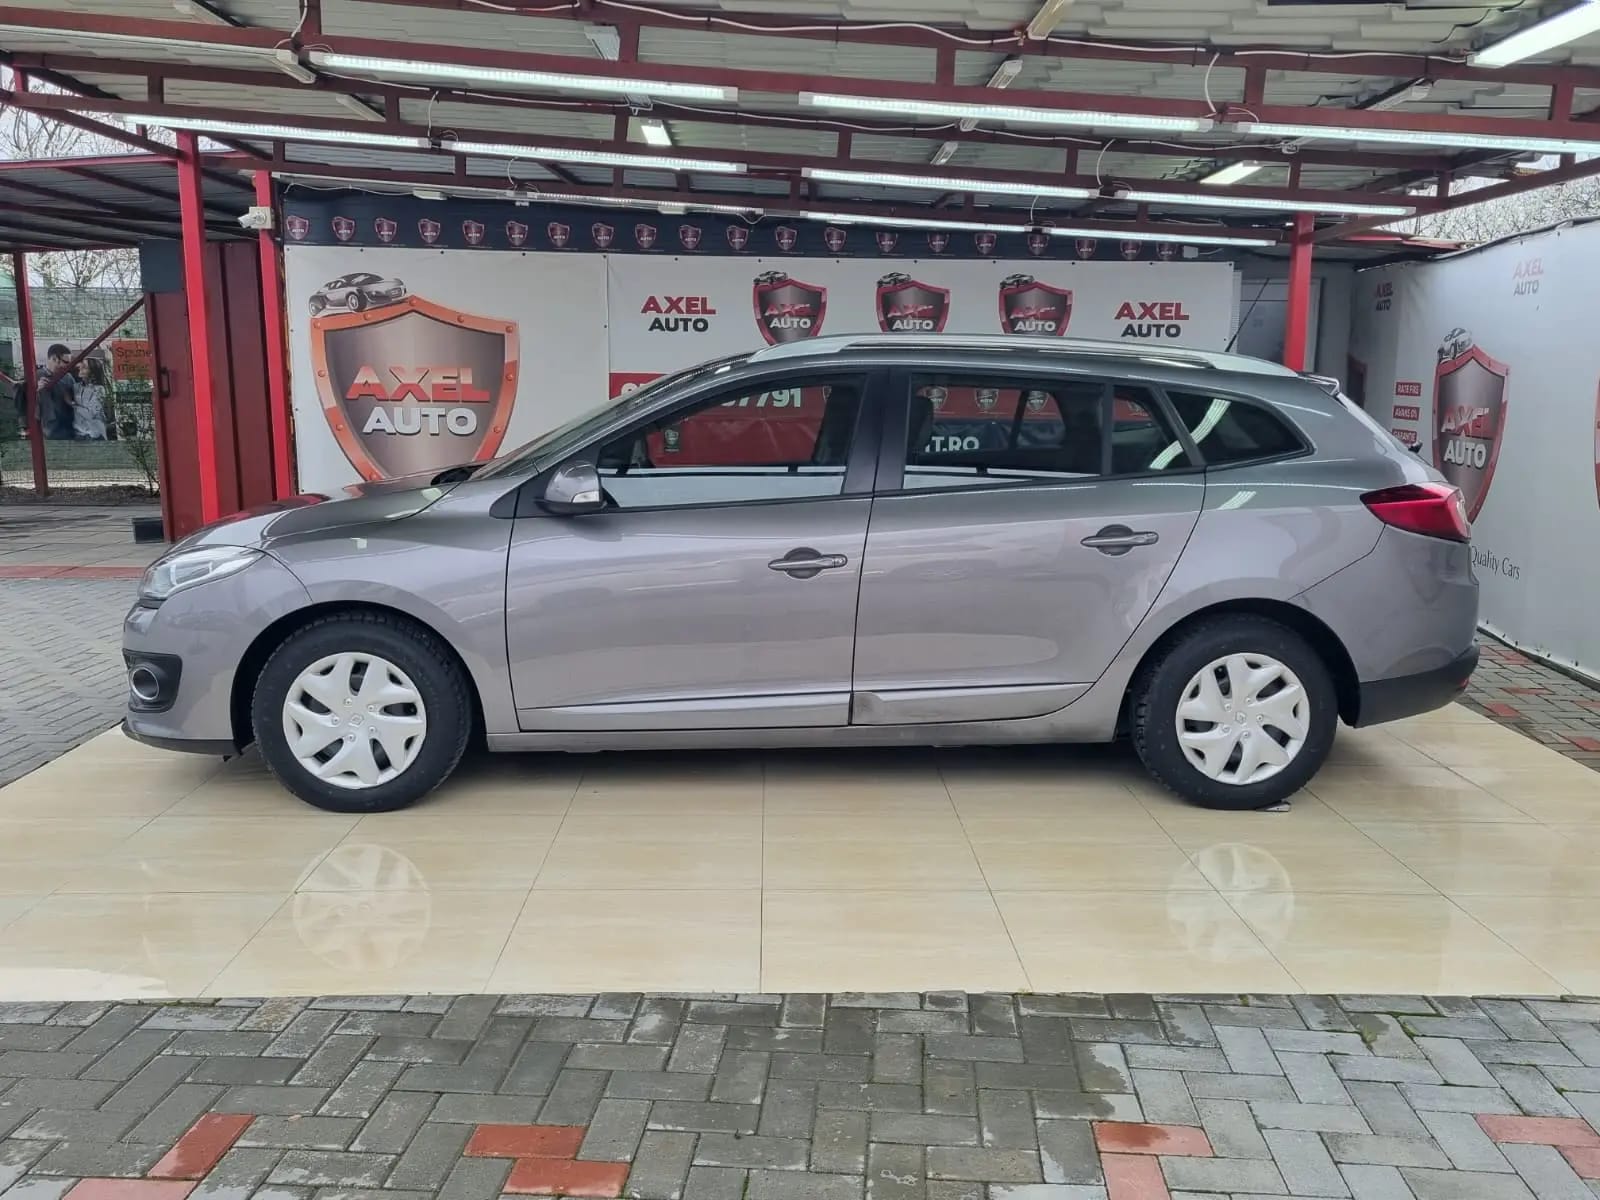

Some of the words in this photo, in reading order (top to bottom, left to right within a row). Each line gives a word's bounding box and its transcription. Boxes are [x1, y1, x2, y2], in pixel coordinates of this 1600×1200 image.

[1512, 257, 1544, 280] AXEL
[1513, 279, 1539, 296] AUTO
[641, 295, 717, 315] AXEL
[1114, 302, 1190, 320] AXEL
[648, 317, 709, 332] AUTO
[769, 318, 811, 329] AUTO
[892, 319, 934, 330] AUTO
[1014, 320, 1057, 331] AUTO
[1121, 323, 1182, 338] AUTO
[345, 365, 491, 403] AXEL
[362, 406, 478, 436] AUTO
[1441, 404, 1492, 439] AXEL
[1443, 439, 1487, 469] AUTO
[1501, 556, 1521, 580] Cars
